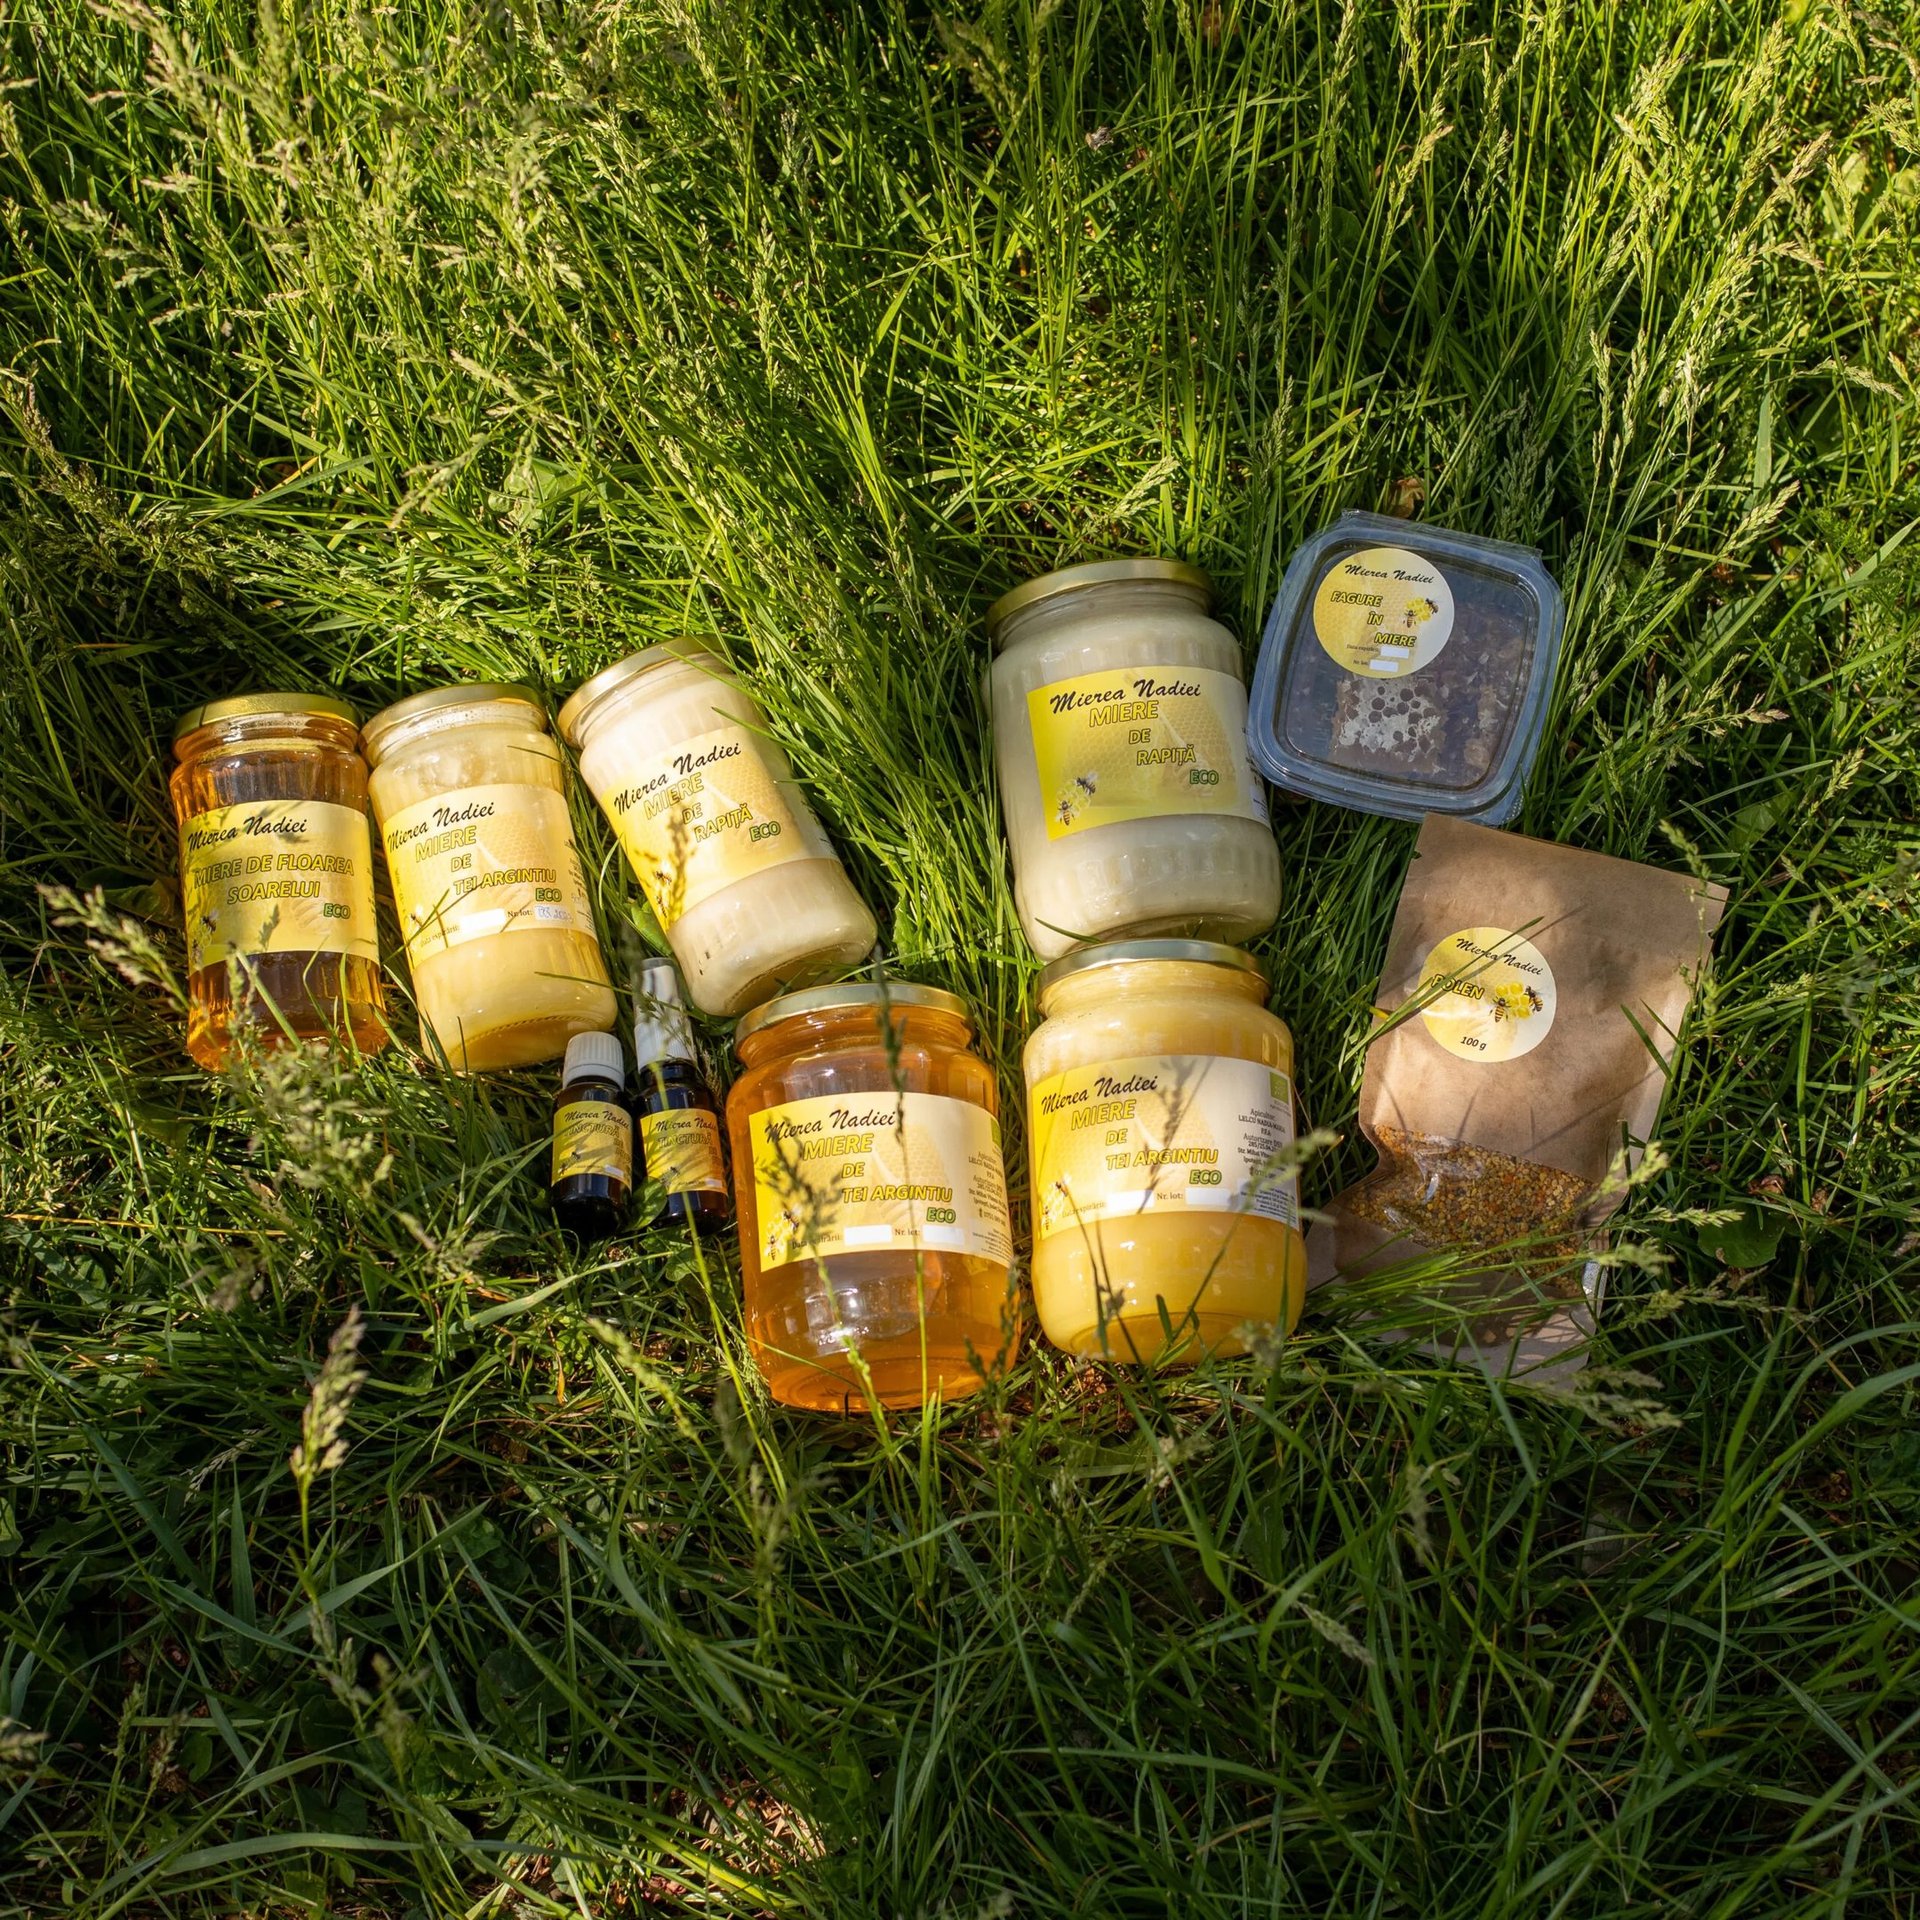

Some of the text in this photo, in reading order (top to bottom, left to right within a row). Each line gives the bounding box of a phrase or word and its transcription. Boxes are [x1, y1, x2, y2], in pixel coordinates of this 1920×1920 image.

[1344, 564, 1434, 584] Mierea Nadiei
[1330, 591, 1383, 607] FAGURE
[1367, 611, 1384, 626] ÎN
[1374, 632, 1417, 647] MIERE
[1049, 679, 1202, 715] Mierea Nadiei
[1089, 700, 1160, 728] MIERE
[1128, 728, 1152, 745] DE
[1136, 744, 1197, 767] RAPIȚĂ
[613, 742, 742, 816] Mierea Nadiei
[1189, 769, 1220, 786] ECO
[643, 772, 705, 820] MIERE
[682, 803, 704, 825] DE
[693, 802, 754, 843] RAPIȚĂ
[188, 815, 308, 852] Mierea Nadiei
[387, 801, 496, 853] Mierea Nadiei
[749, 820, 783, 842] ECO
[415, 825, 478, 863] MIERE
[194, 854, 355, 889] MIERE DE FLOAREA
[450, 853, 473, 873] DE
[227, 881, 321, 905] SOARELUI
[453, 876, 478, 896] TEI
[481, 868, 557, 890] ARGINTIU
[535, 888, 563, 903] ECO
[323, 903, 351, 919] ECO
[1503, 953, 1544, 976] Nadiei
[1460, 1036, 1487, 1051] 100 g
[1041, 1075, 1158, 1116] Mierea Nadiei
[655, 1120, 691, 1132] Merea
[1071, 1099, 1137, 1131] MIERE
[765, 1109, 896, 1144] Mierea Nadiei
[1105, 1128, 1128, 1146] DE
[802, 1133, 874, 1161] MIERE
[1106, 1147, 1219, 1170] TEI ARGINTIU
[841, 1162, 865, 1179] DE
[1189, 1169, 1222, 1185] ECO
[842, 1186, 868, 1203] TEI
[870, 1185, 953, 1203] ARGINTIU
[1156, 1192, 1183, 1200] Nr. lot:
[926, 1207, 956, 1224] ECO
